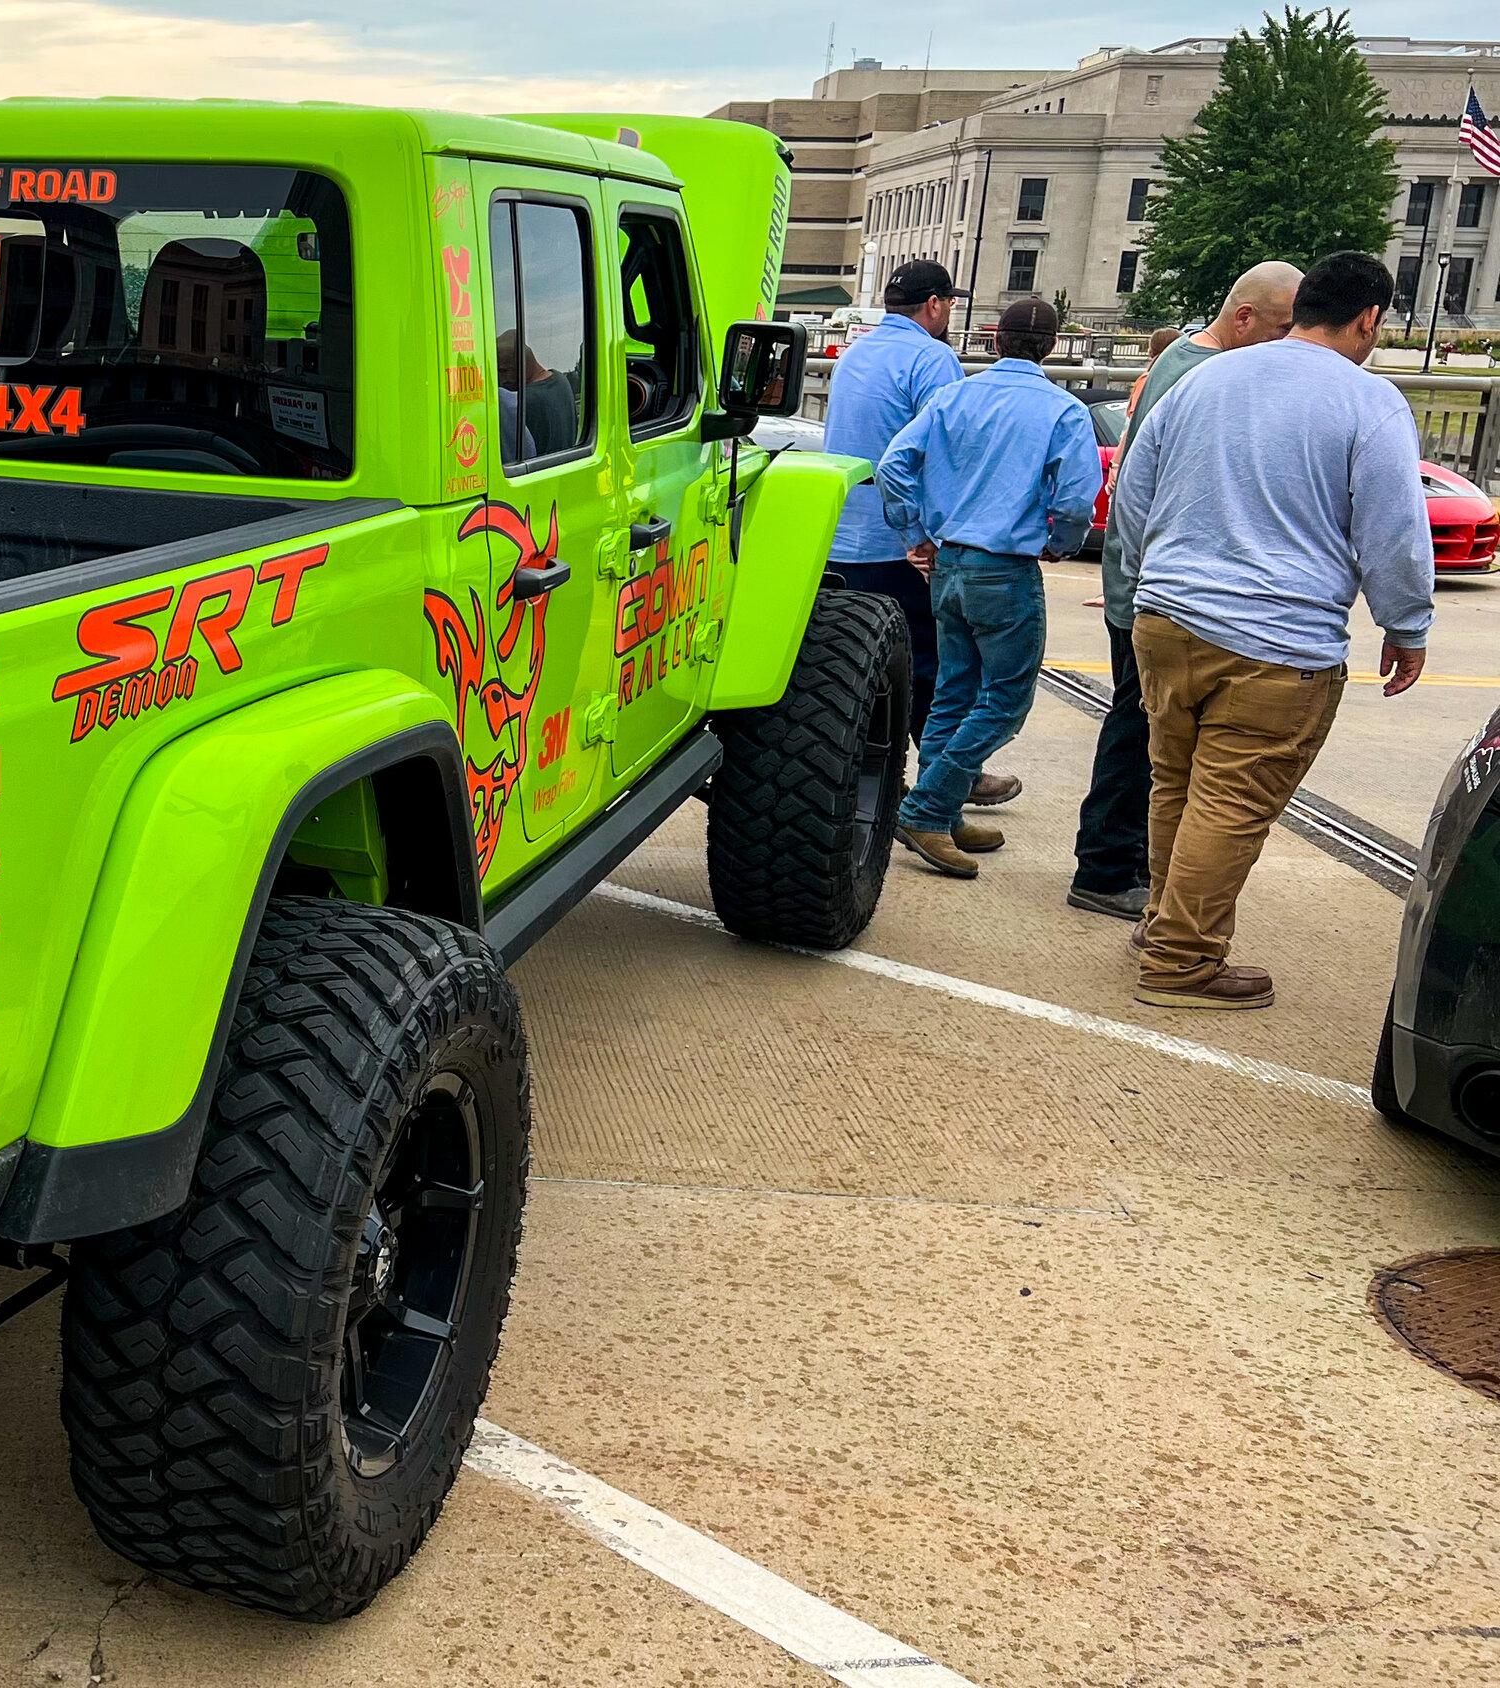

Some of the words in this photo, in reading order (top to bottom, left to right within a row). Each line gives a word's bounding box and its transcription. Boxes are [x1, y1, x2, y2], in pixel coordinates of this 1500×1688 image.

[10, 168, 118, 203] ROAD
[768, 174, 787, 252] ROAD
[760, 247, 777, 303] OFF
[52, 542, 329, 702] SRT
[614, 538, 709, 658] CROWN
[617, 611, 699, 713] RALLY
[538, 704, 571, 770] 3M
